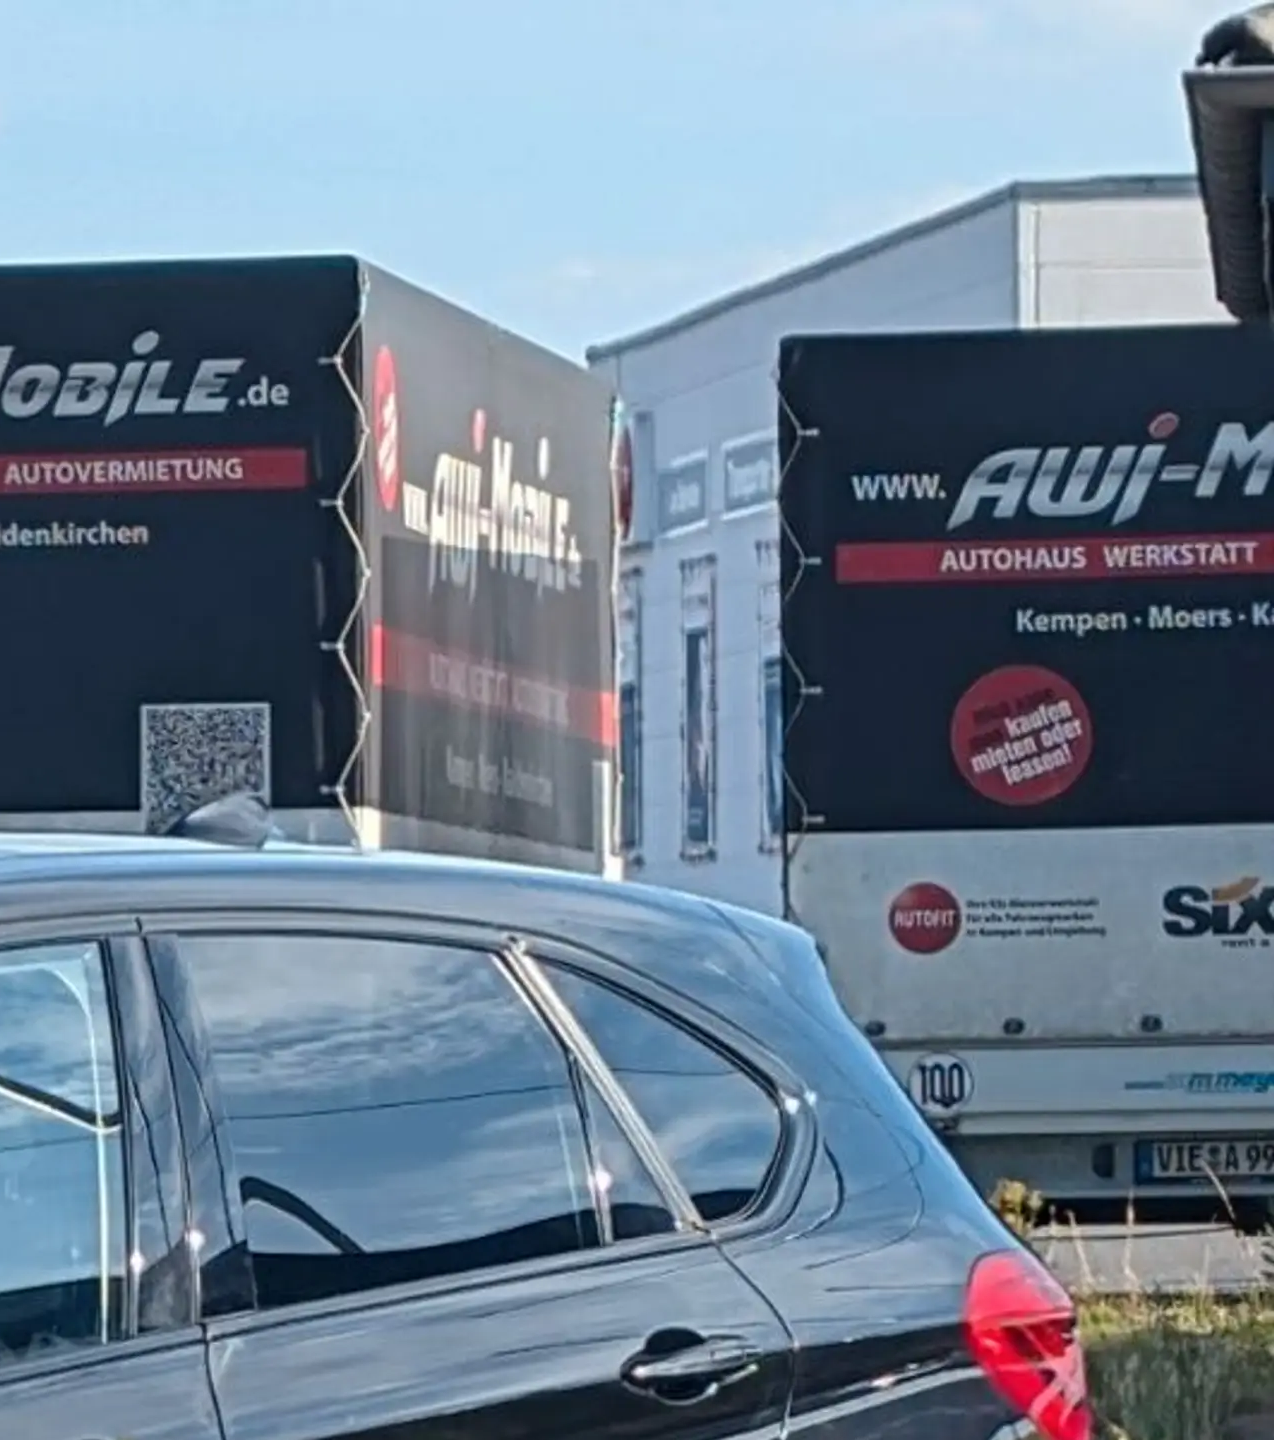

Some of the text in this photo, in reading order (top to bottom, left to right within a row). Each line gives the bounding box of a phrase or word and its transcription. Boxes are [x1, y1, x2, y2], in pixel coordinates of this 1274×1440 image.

[4, 457, 244, 487] AUTOVERMIETUNG
[940, 541, 1259, 574] AUTOHAUS WERKSTATT
[1016, 602, 1274, 637] Kempen Moers K
[894, 909, 956, 929] AUTOFIT
[918, 1062, 966, 1107] 100
[1156, 1143, 1203, 1173] VIE
[1225, 1142, 1239, 1172] A
